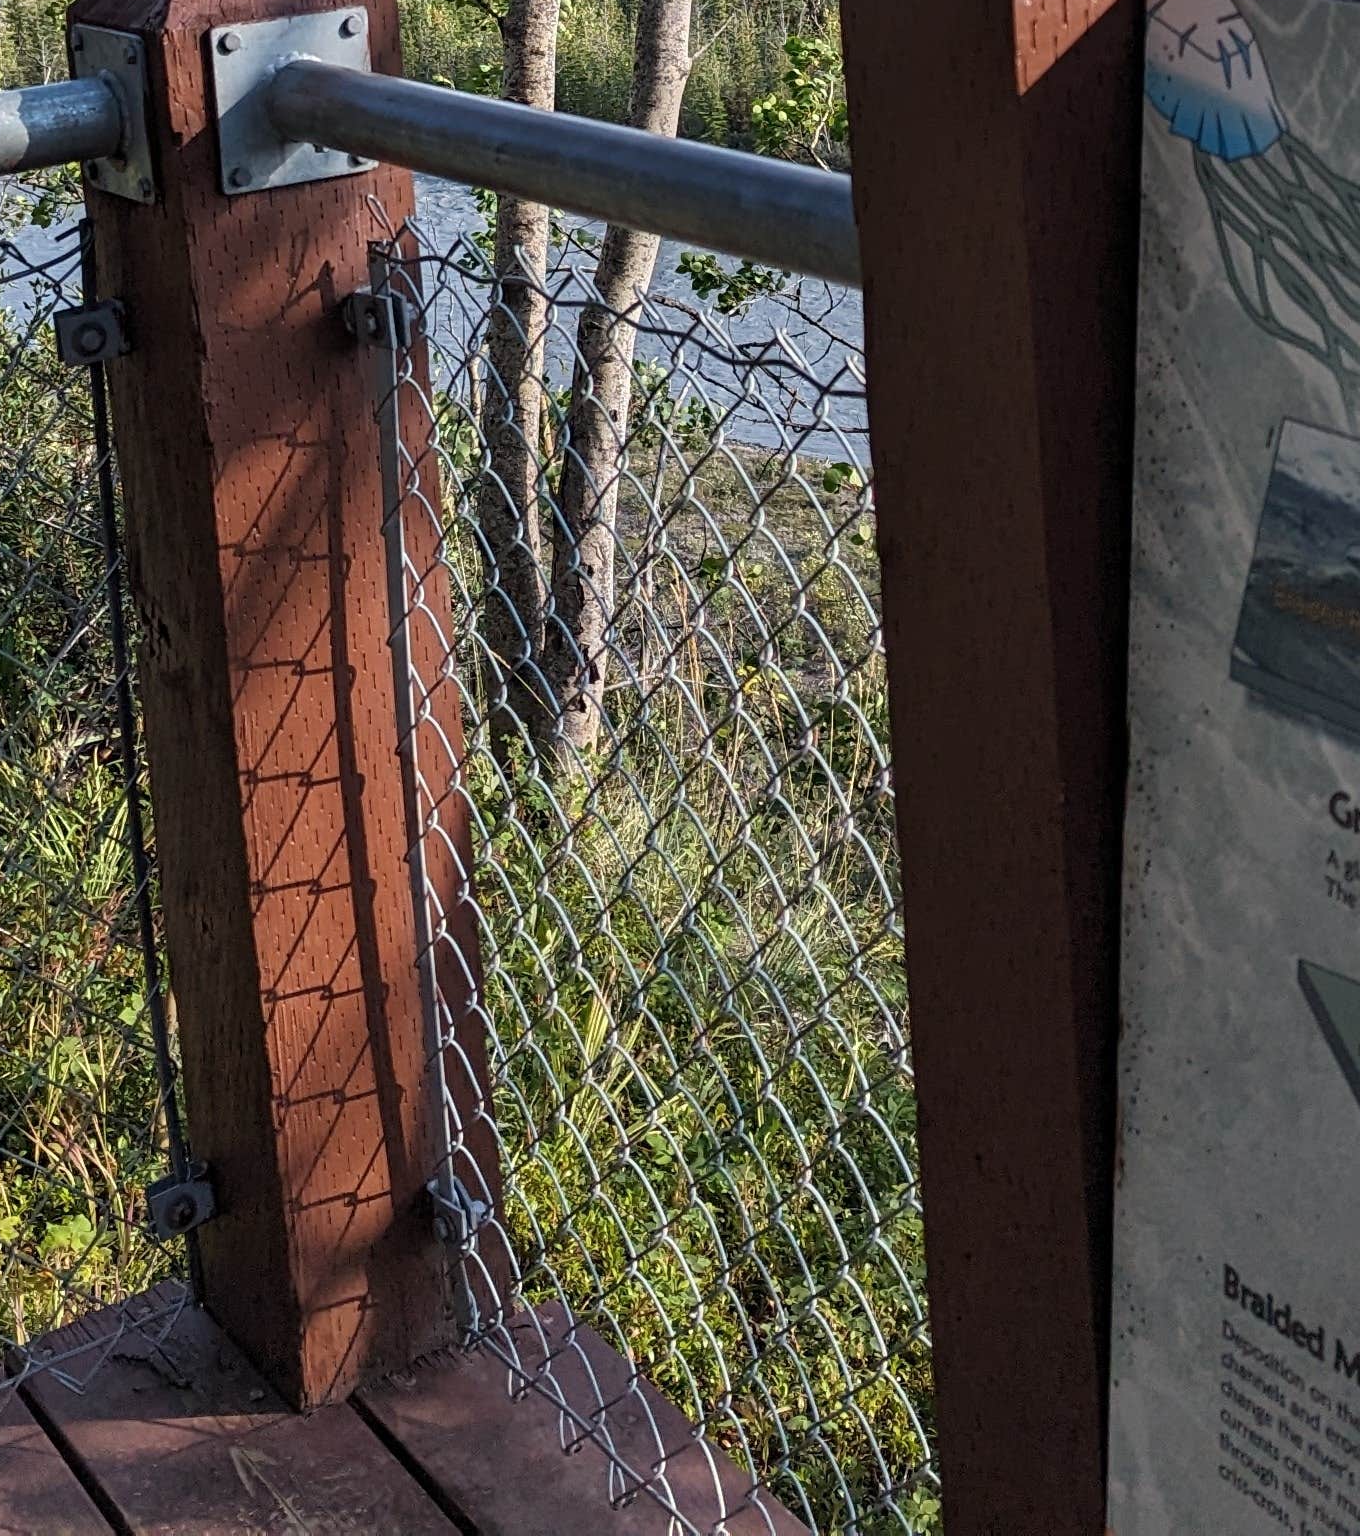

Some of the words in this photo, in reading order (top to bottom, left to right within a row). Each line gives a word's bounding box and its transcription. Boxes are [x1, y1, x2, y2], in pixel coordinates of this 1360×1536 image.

[1326, 849, 1339, 869] A
[1324, 875, 1356, 910] The
[1223, 1263, 1326, 1361] Braided
[1222, 1319, 1306, 1393] Deposition
[1309, 1386, 1332, 1412] on
[1290, 1401, 1321, 1433] and
